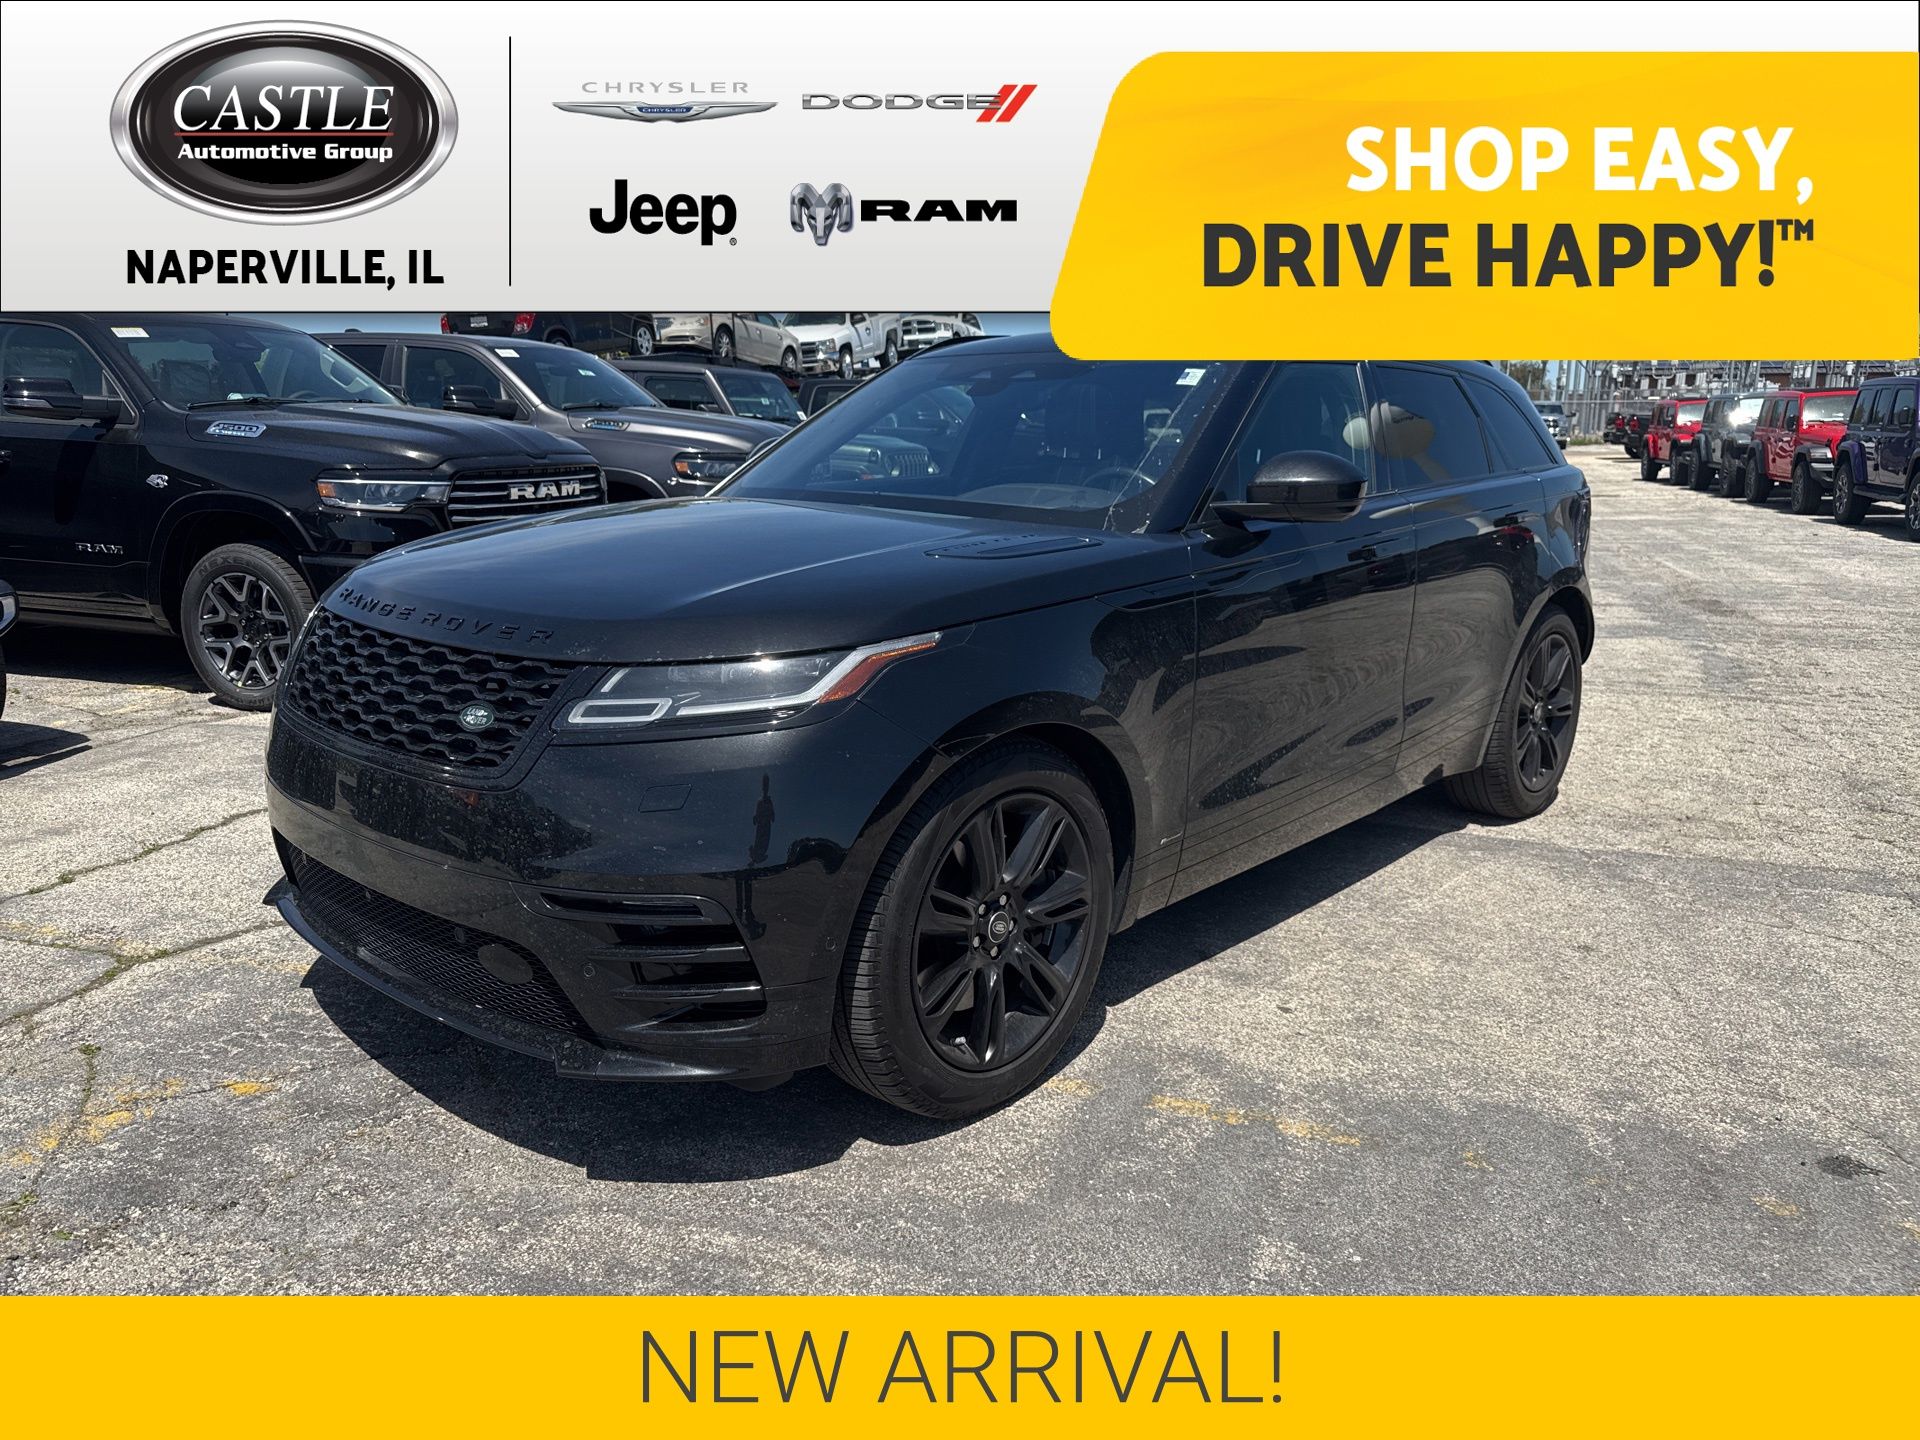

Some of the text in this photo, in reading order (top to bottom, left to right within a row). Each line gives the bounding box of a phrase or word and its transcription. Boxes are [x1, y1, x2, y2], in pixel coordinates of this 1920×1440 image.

[218, 423, 258, 432] 1500
[507, 480, 581, 500] RAM
[75, 542, 124, 555] RAM
[338, 587, 555, 645] RANGE ROVER
[466, 707, 485, 716] LAND
[465, 715, 487, 725] ROVER
